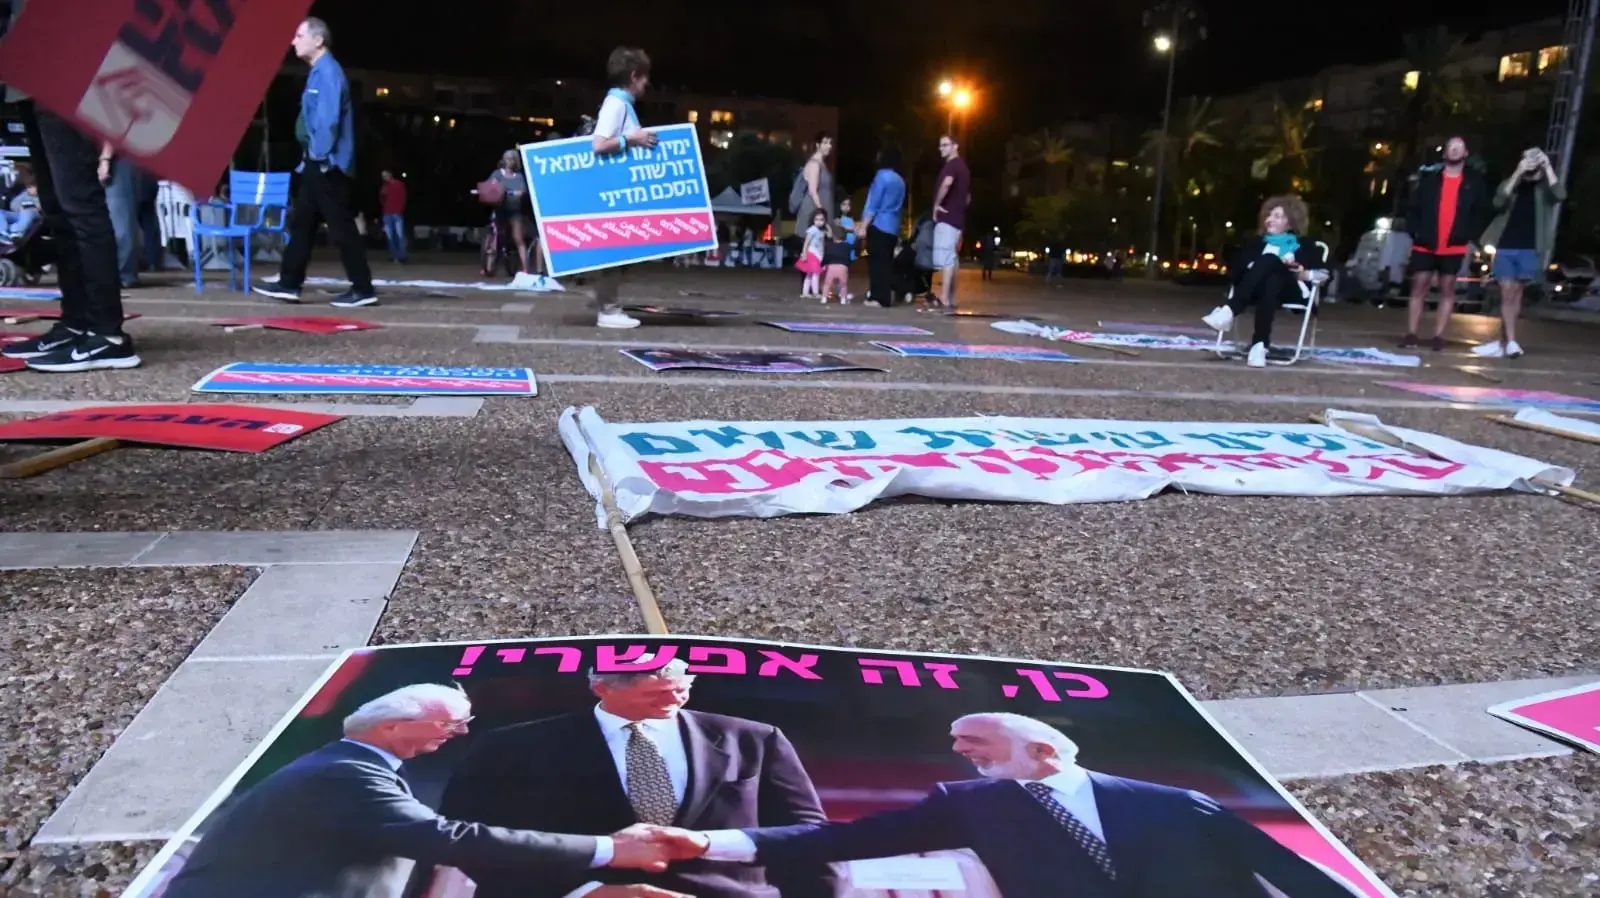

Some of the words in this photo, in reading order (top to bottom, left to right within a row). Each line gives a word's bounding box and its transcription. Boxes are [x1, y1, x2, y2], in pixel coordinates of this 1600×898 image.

[656, 138, 690, 161] ימין,
[629, 158, 695, 183] דורשות
[599, 186, 648, 207] מדיני
[652, 179, 699, 200] הסכם
[617, 424, 878, 456] שלום
[451, 644, 825, 681] אפשרי!
[857, 658, 961, 689] זה
